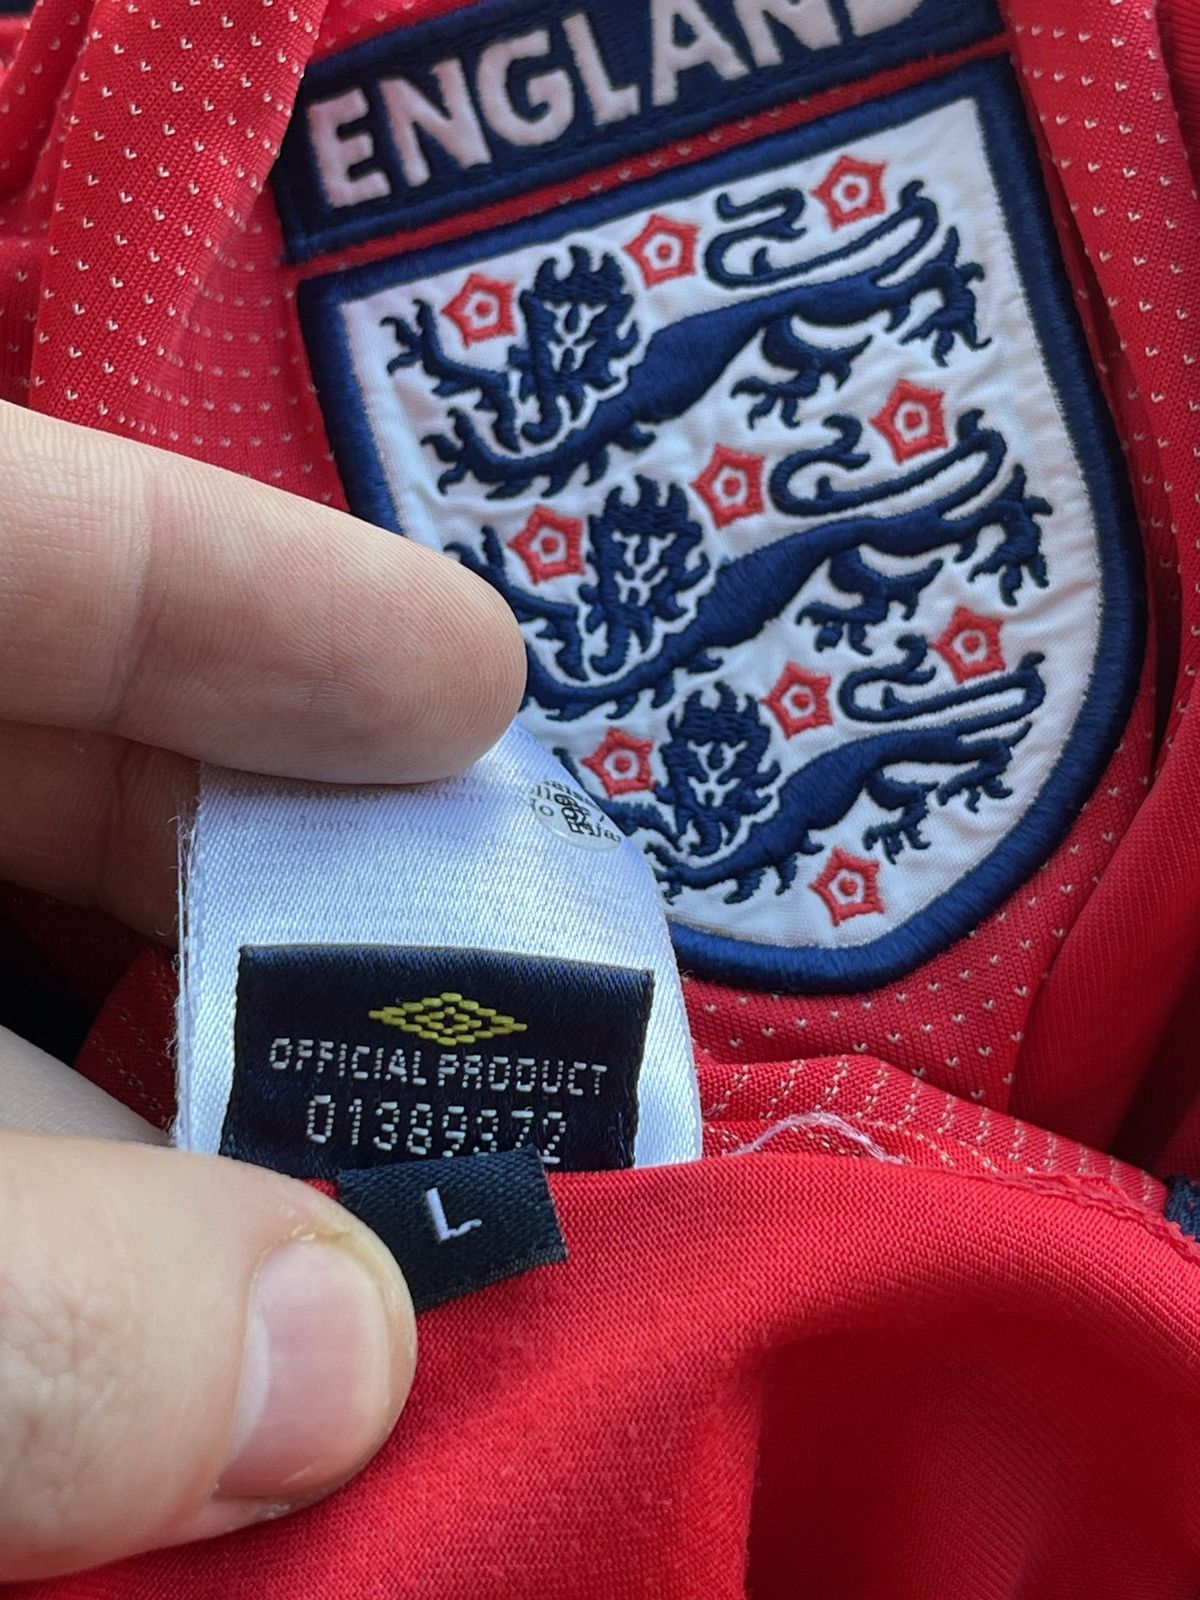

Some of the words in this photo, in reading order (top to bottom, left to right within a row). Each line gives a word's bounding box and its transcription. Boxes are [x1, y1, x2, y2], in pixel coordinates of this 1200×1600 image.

[268, 1037, 427, 1086] OFFICIAL
[437, 1053, 608, 1096] PRODUCT
[306, 1095, 566, 1164] 01389372
[425, 1187, 482, 1243] L
